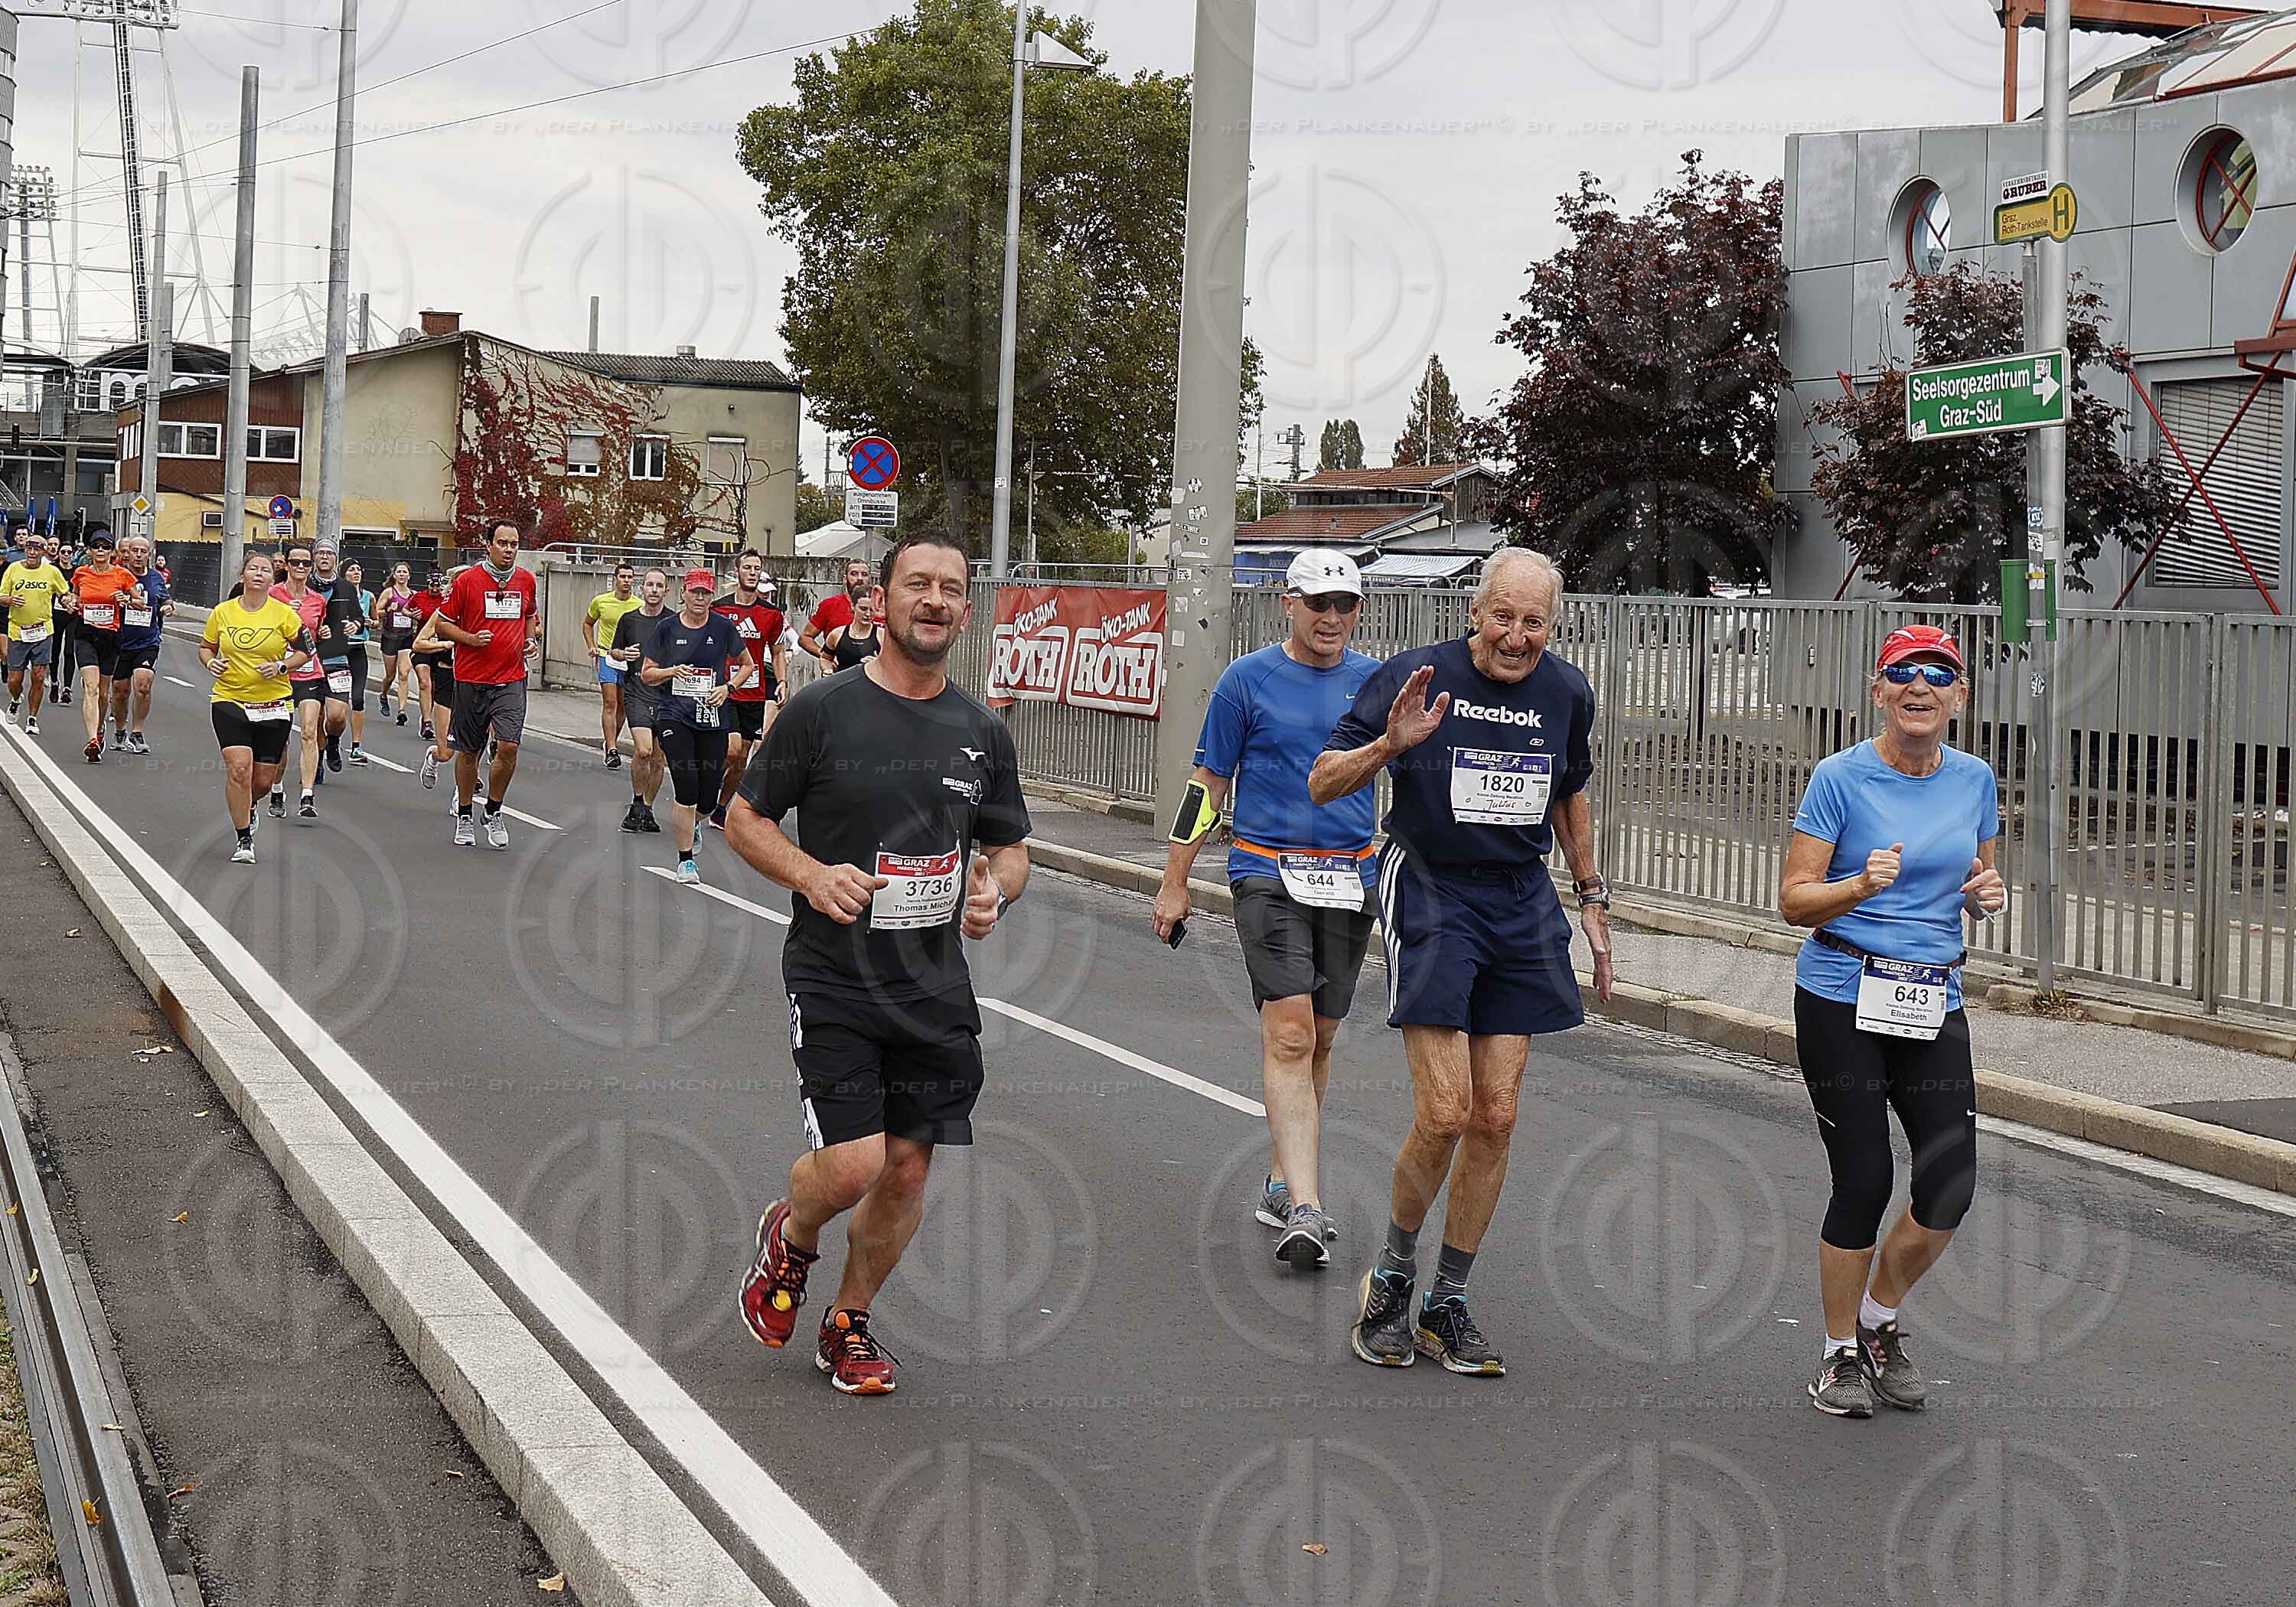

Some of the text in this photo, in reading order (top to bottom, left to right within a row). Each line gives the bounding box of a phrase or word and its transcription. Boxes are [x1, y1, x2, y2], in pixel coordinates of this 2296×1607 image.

[2003, 181, 2047, 199] GRUBER
[2053, 194, 2069, 231] H
[2002, 217, 2048, 234] Roth-Tankstelle
[1913, 368, 2030, 401] Seelsorgezentrum
[1939, 398, 2002, 428] Graz-Süd
[1013, 597, 1058, 637] ÖKO-TANK
[1101, 601, 1150, 643] ÖKO-TANK
[994, 637, 1062, 688] ROTH
[1074, 643, 1155, 699] ROTH
[1453, 699, 1543, 728] Reebok
[1478, 753, 1504, 762] GRAZ
[955, 781, 973, 790] GRAZ
[1480, 774, 1525, 793] 1820
[904, 859, 930, 867] GRAZ
[905, 876, 953, 897] 3736
[1307, 874, 1334, 886] 644
[1888, 963, 1913, 973] GRAZ
[1894, 986, 1929, 1005] 643
[1890, 1009, 1927, 1021] Elisabeth
